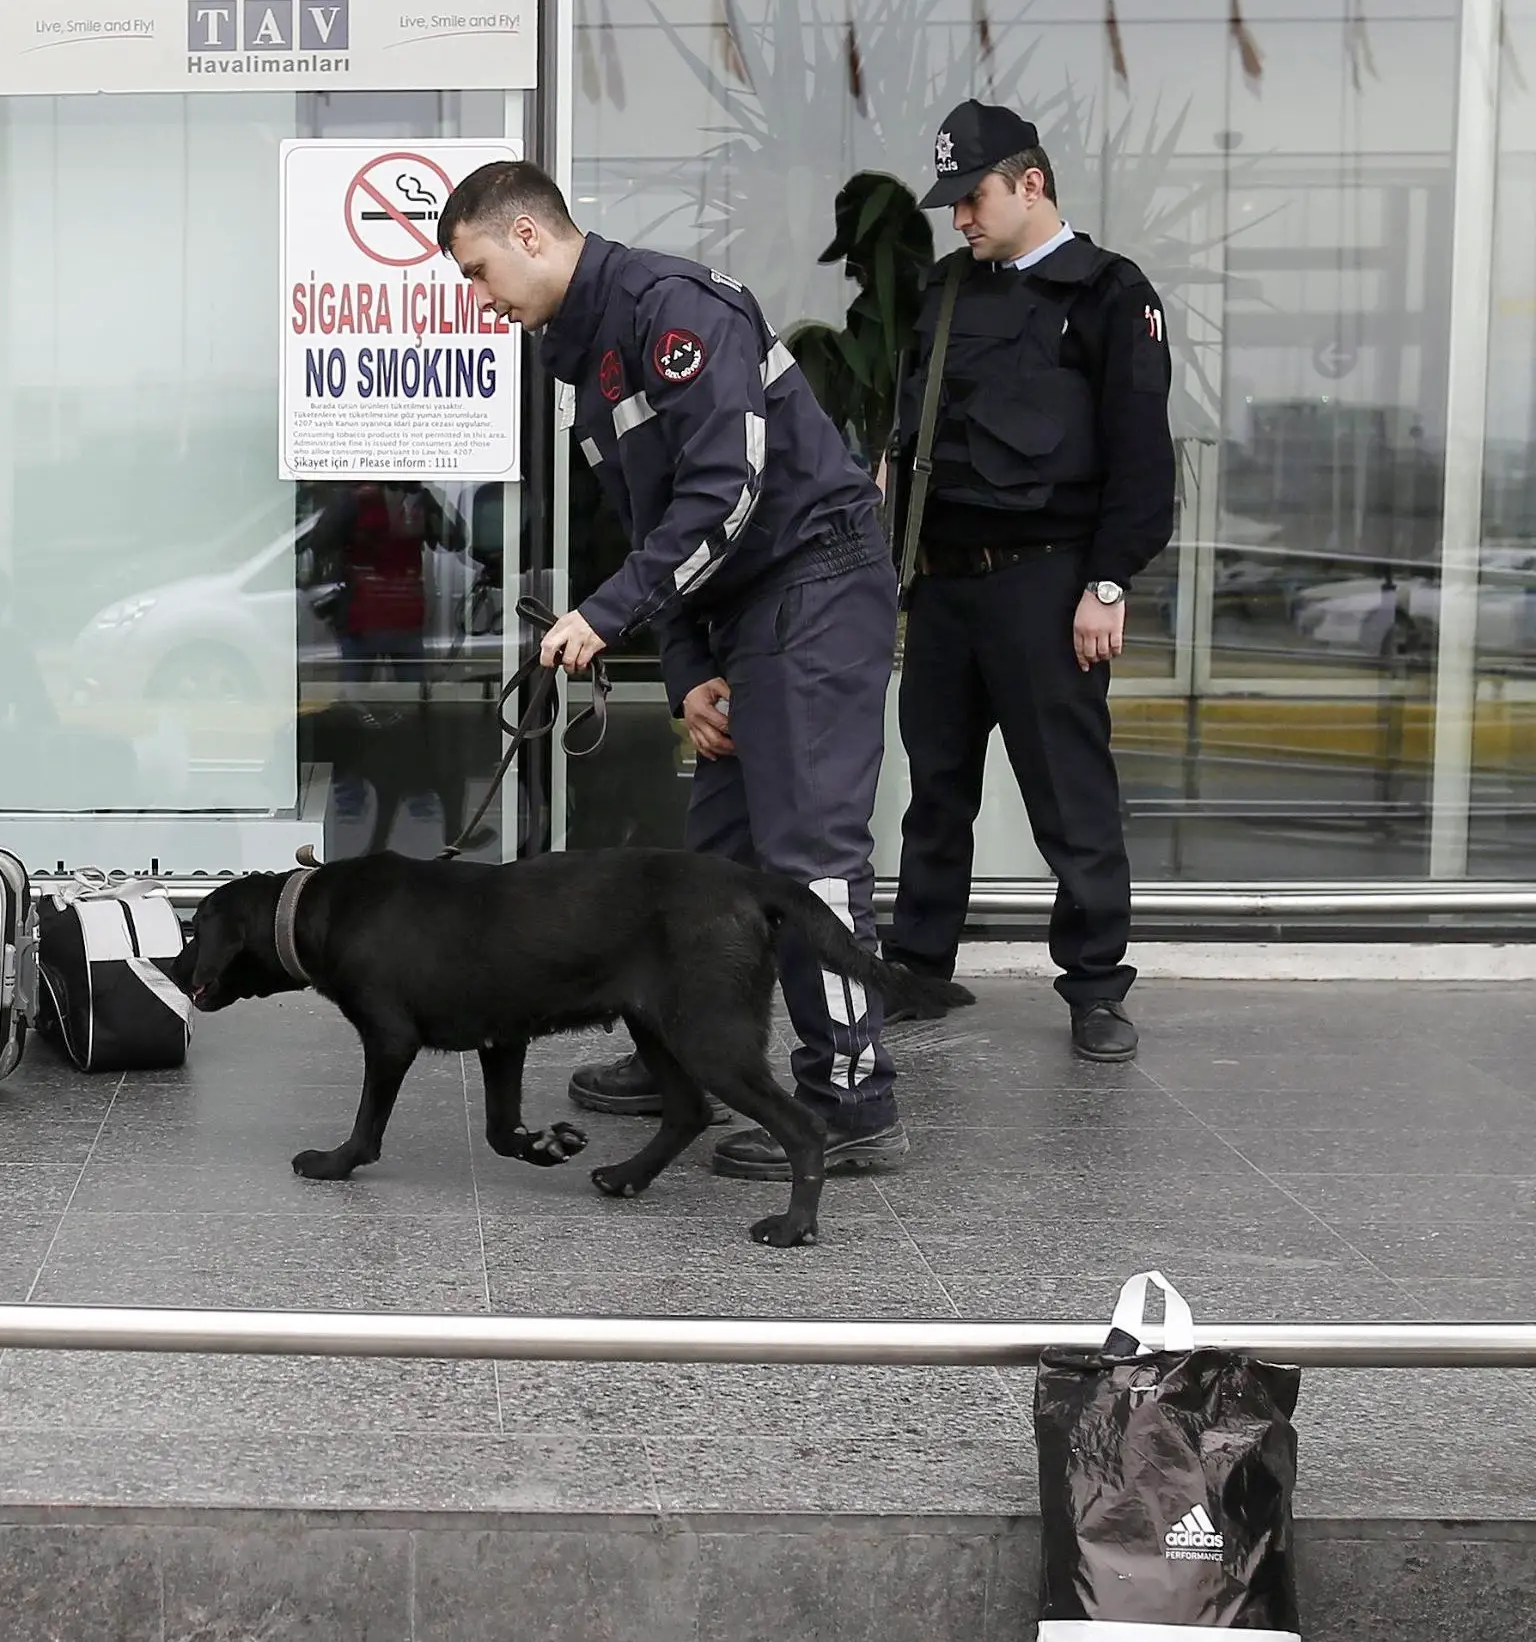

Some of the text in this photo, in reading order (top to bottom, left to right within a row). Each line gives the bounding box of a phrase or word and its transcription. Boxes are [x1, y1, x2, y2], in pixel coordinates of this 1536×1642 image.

[35, 19, 155, 34] Live, Smile and Fly!
[196, 6, 342, 46] TAV
[399, 14, 521, 30] Live, Smile and Fly!
[187, 55, 350, 74] Havalimanları
[936, 159, 958, 173] OLİS
[291, 270, 393, 335] SİGARA
[661, 341, 693, 366] TAV
[305, 347, 497, 398] NO SMOKING
[292, 431, 335, 439] Consuming
[367, 431, 401, 440] products
[425, 431, 462, 440] permitted
[293, 456, 329, 469] Şikayet
[331, 456, 349, 469] için
[359, 457, 391, 467] Please
[393, 456, 426, 467] inform
[435, 457, 459, 468] 1111
[1164, 1530, 1224, 1548] adidas
[1165, 1551, 1224, 1562] PERFORMANCE
